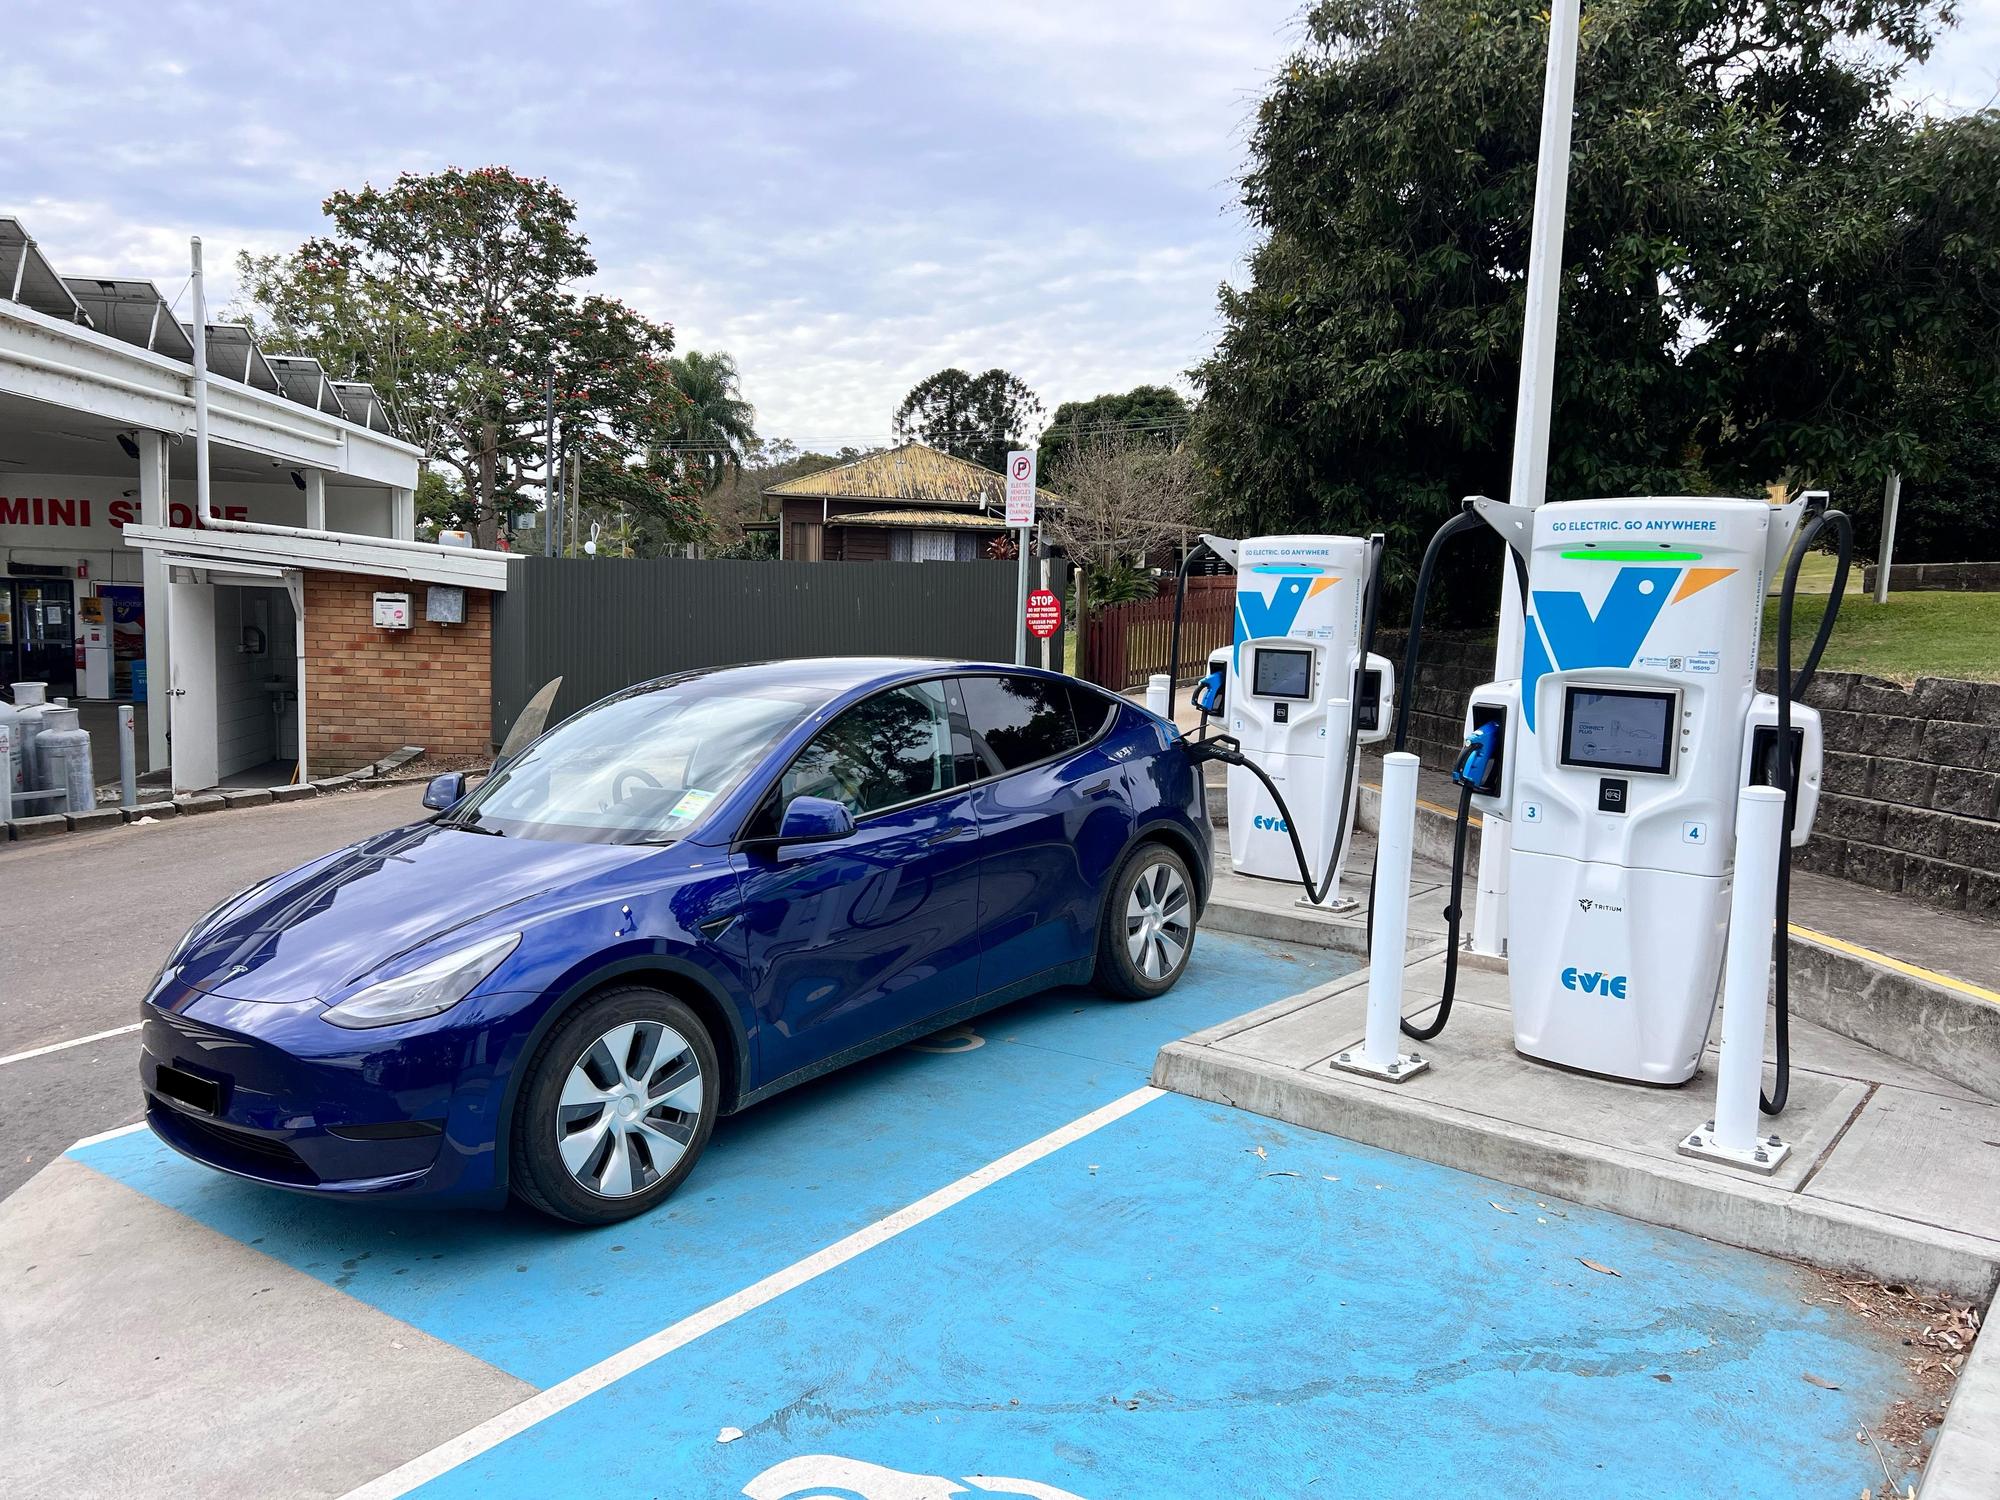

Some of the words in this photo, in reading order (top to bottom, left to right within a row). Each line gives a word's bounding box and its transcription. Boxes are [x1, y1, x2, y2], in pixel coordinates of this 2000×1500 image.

[0, 497, 91, 527] MINI
[108, 500, 248, 530] SOE
[1552, 523, 1567, 531] GO
[1569, 521, 1621, 531] ELECTRIC.
[1624, 521, 1643, 530] GO
[1645, 520, 1717, 531] ANYWHERE
[1031, 595, 1053, 606] STOP
[1528, 807, 1536, 818] 3
[1689, 827, 1699, 839] 4
[1595, 903, 1622, 912] TRITIUM
